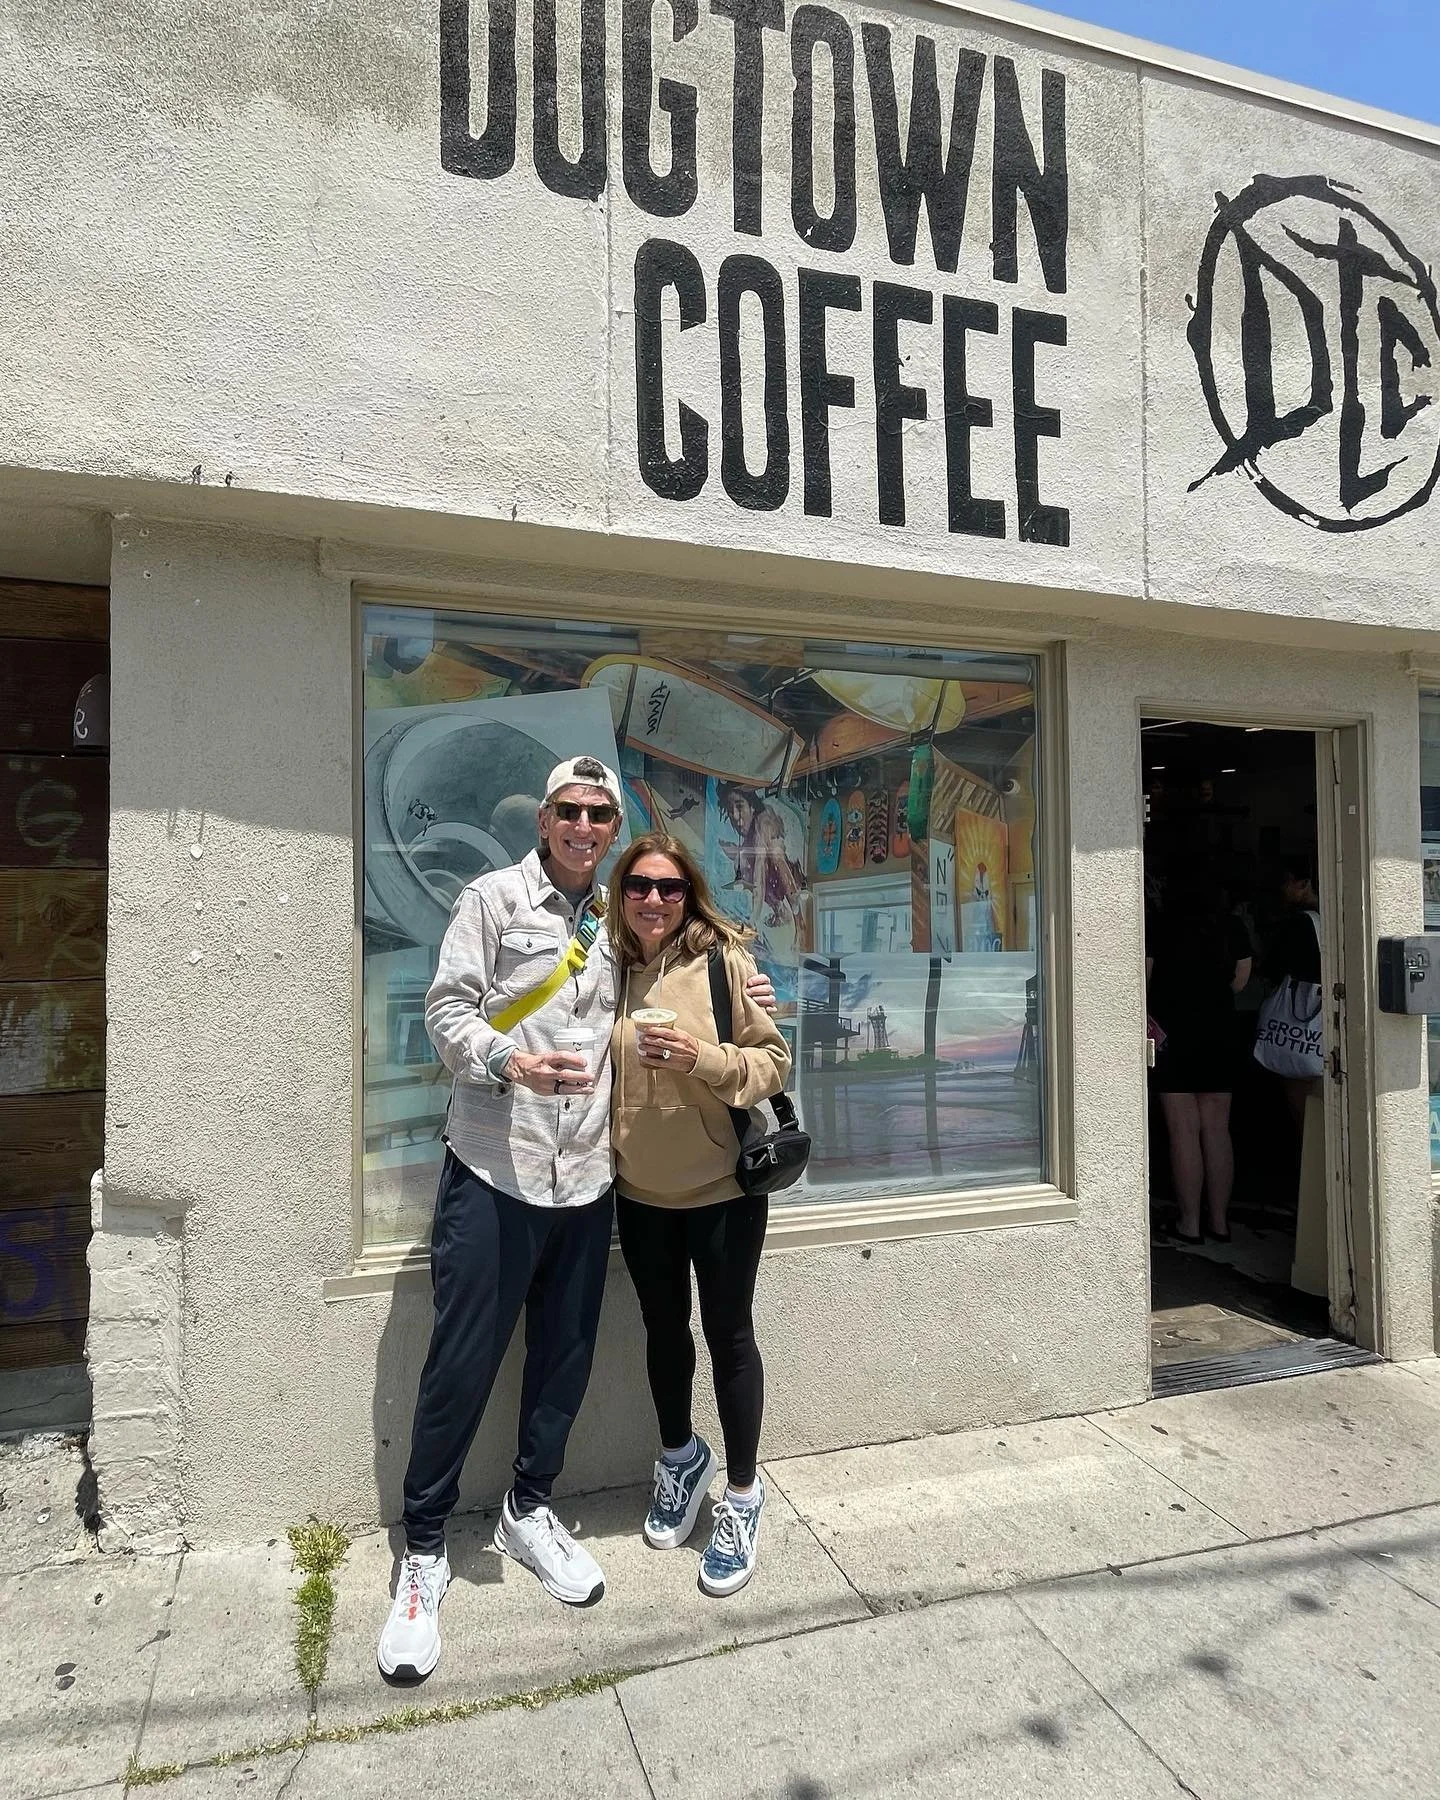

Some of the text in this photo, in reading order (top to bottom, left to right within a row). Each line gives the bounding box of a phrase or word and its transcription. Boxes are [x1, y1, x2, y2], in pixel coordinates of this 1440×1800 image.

[440, 0, 1067, 294] DOGTOWN
[634, 238, 1070, 547] COFFEE
[1267, 1018, 1323, 1042] GROW
